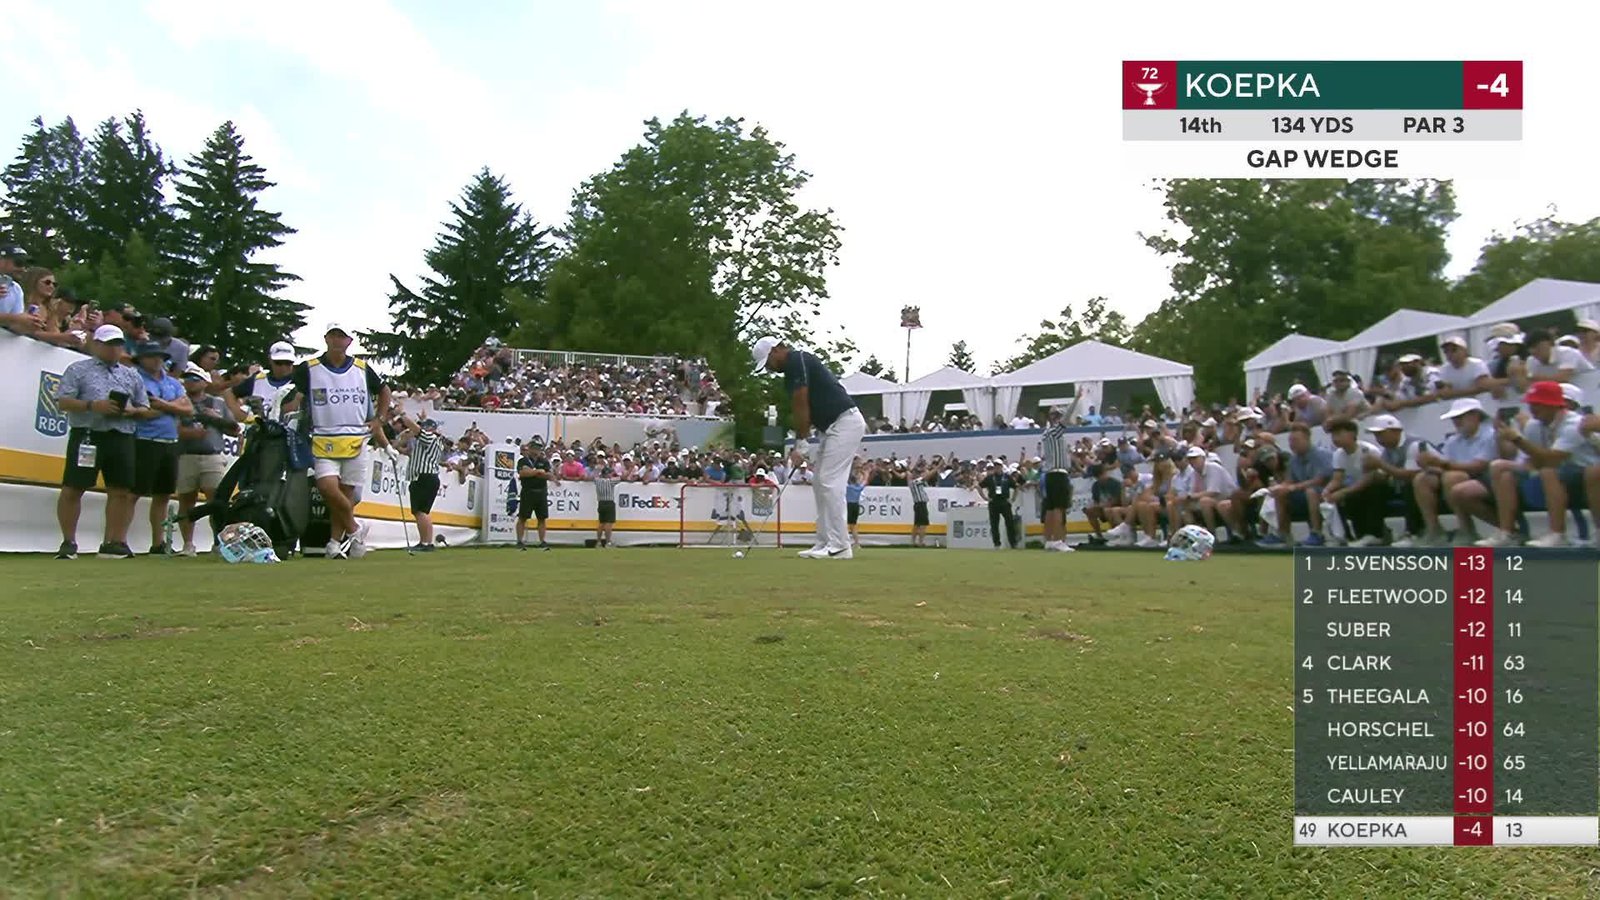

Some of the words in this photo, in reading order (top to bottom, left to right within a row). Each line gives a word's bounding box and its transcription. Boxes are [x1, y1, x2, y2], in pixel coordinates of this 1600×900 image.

[39, 415, 66, 434] RBC
[631, 496, 670, 509] FedEx
[965, 527, 988, 538] OPE
